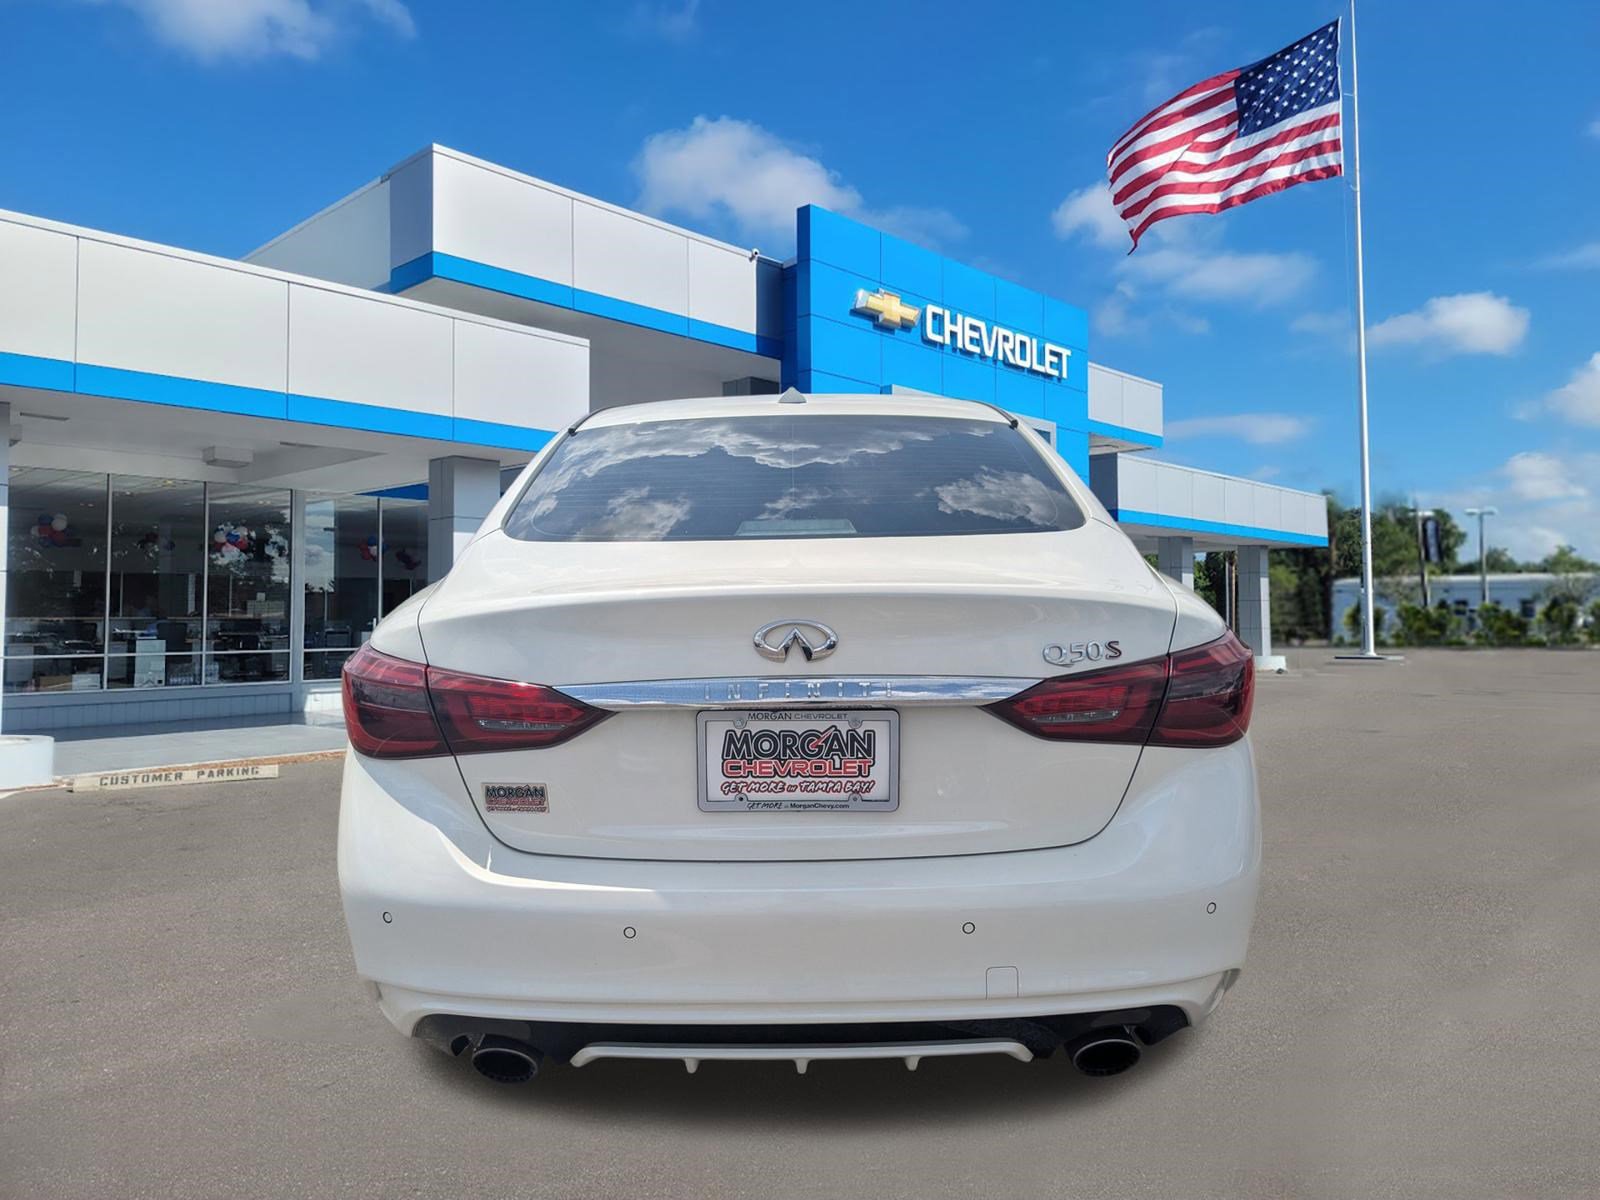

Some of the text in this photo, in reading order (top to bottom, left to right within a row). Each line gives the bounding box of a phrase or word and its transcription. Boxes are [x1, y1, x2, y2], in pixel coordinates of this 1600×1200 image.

[924, 304, 1072, 379] CHEVROLET
[704, 681, 893, 700] INFINITI
[747, 712, 849, 721] MORGAN CHEVROLET
[722, 727, 876, 760] MORGAN
[100, 766, 260, 787] CUSTOMER PARKING
[722, 759, 875, 778] CHEVROLET
[485, 784, 546, 799] MORGAN
[721, 780, 748, 795] GET
[747, 780, 786, 794] MORE
[800, 780, 843, 794] TAMPA
[843, 780, 876, 794] BAY!
[747, 802, 762, 810] GET
[761, 802, 783, 810] MORE
[790, 802, 850, 810] MorganChevy.com
